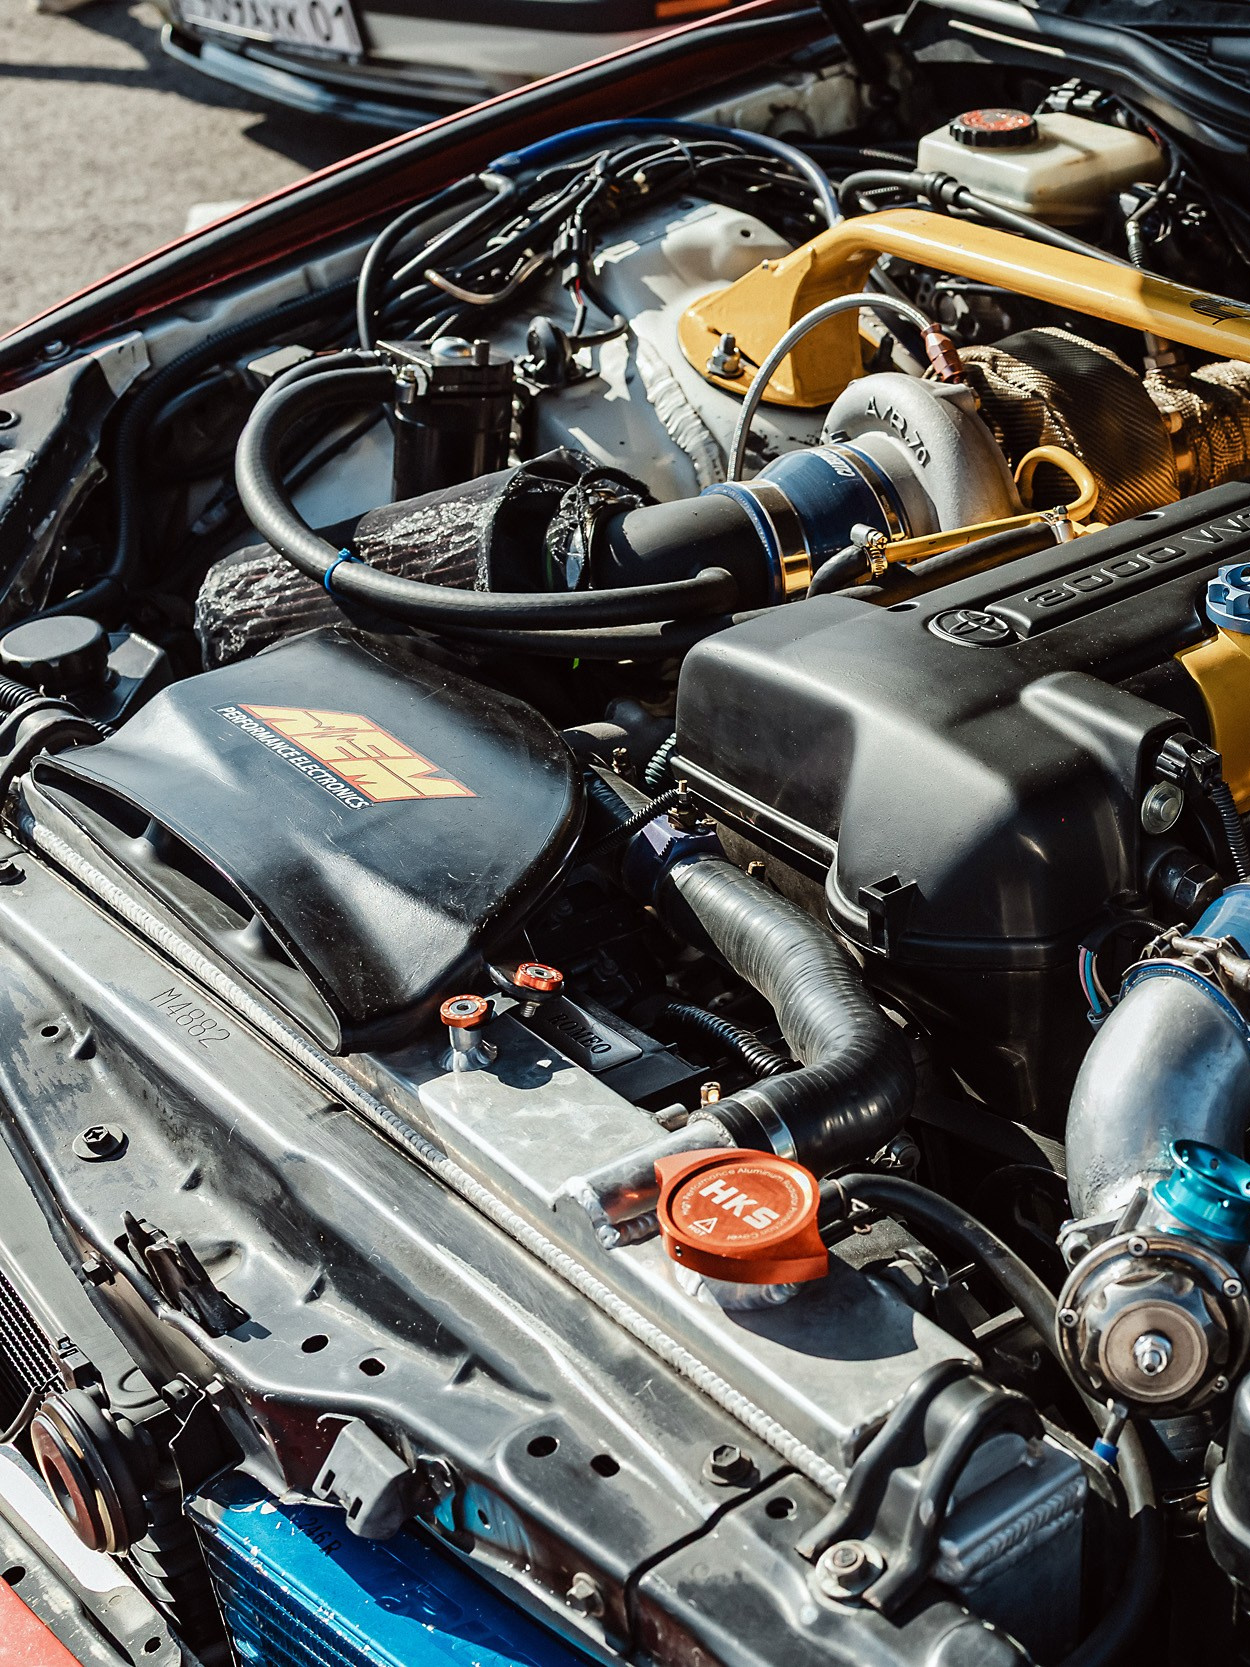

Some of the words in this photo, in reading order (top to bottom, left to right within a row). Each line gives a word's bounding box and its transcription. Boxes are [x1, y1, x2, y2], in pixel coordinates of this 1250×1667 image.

[1024, 545, 1187, 609] 3000
[216, 705, 300, 765] PERFORMANCE
[292, 754, 369, 810] ELECTRONICS
[149, 986, 231, 1049] M4882
[736, 1167, 785, 1183] Aluminum
[687, 1223, 708, 1236] HOT
[698, 1178, 780, 1230] HKS
